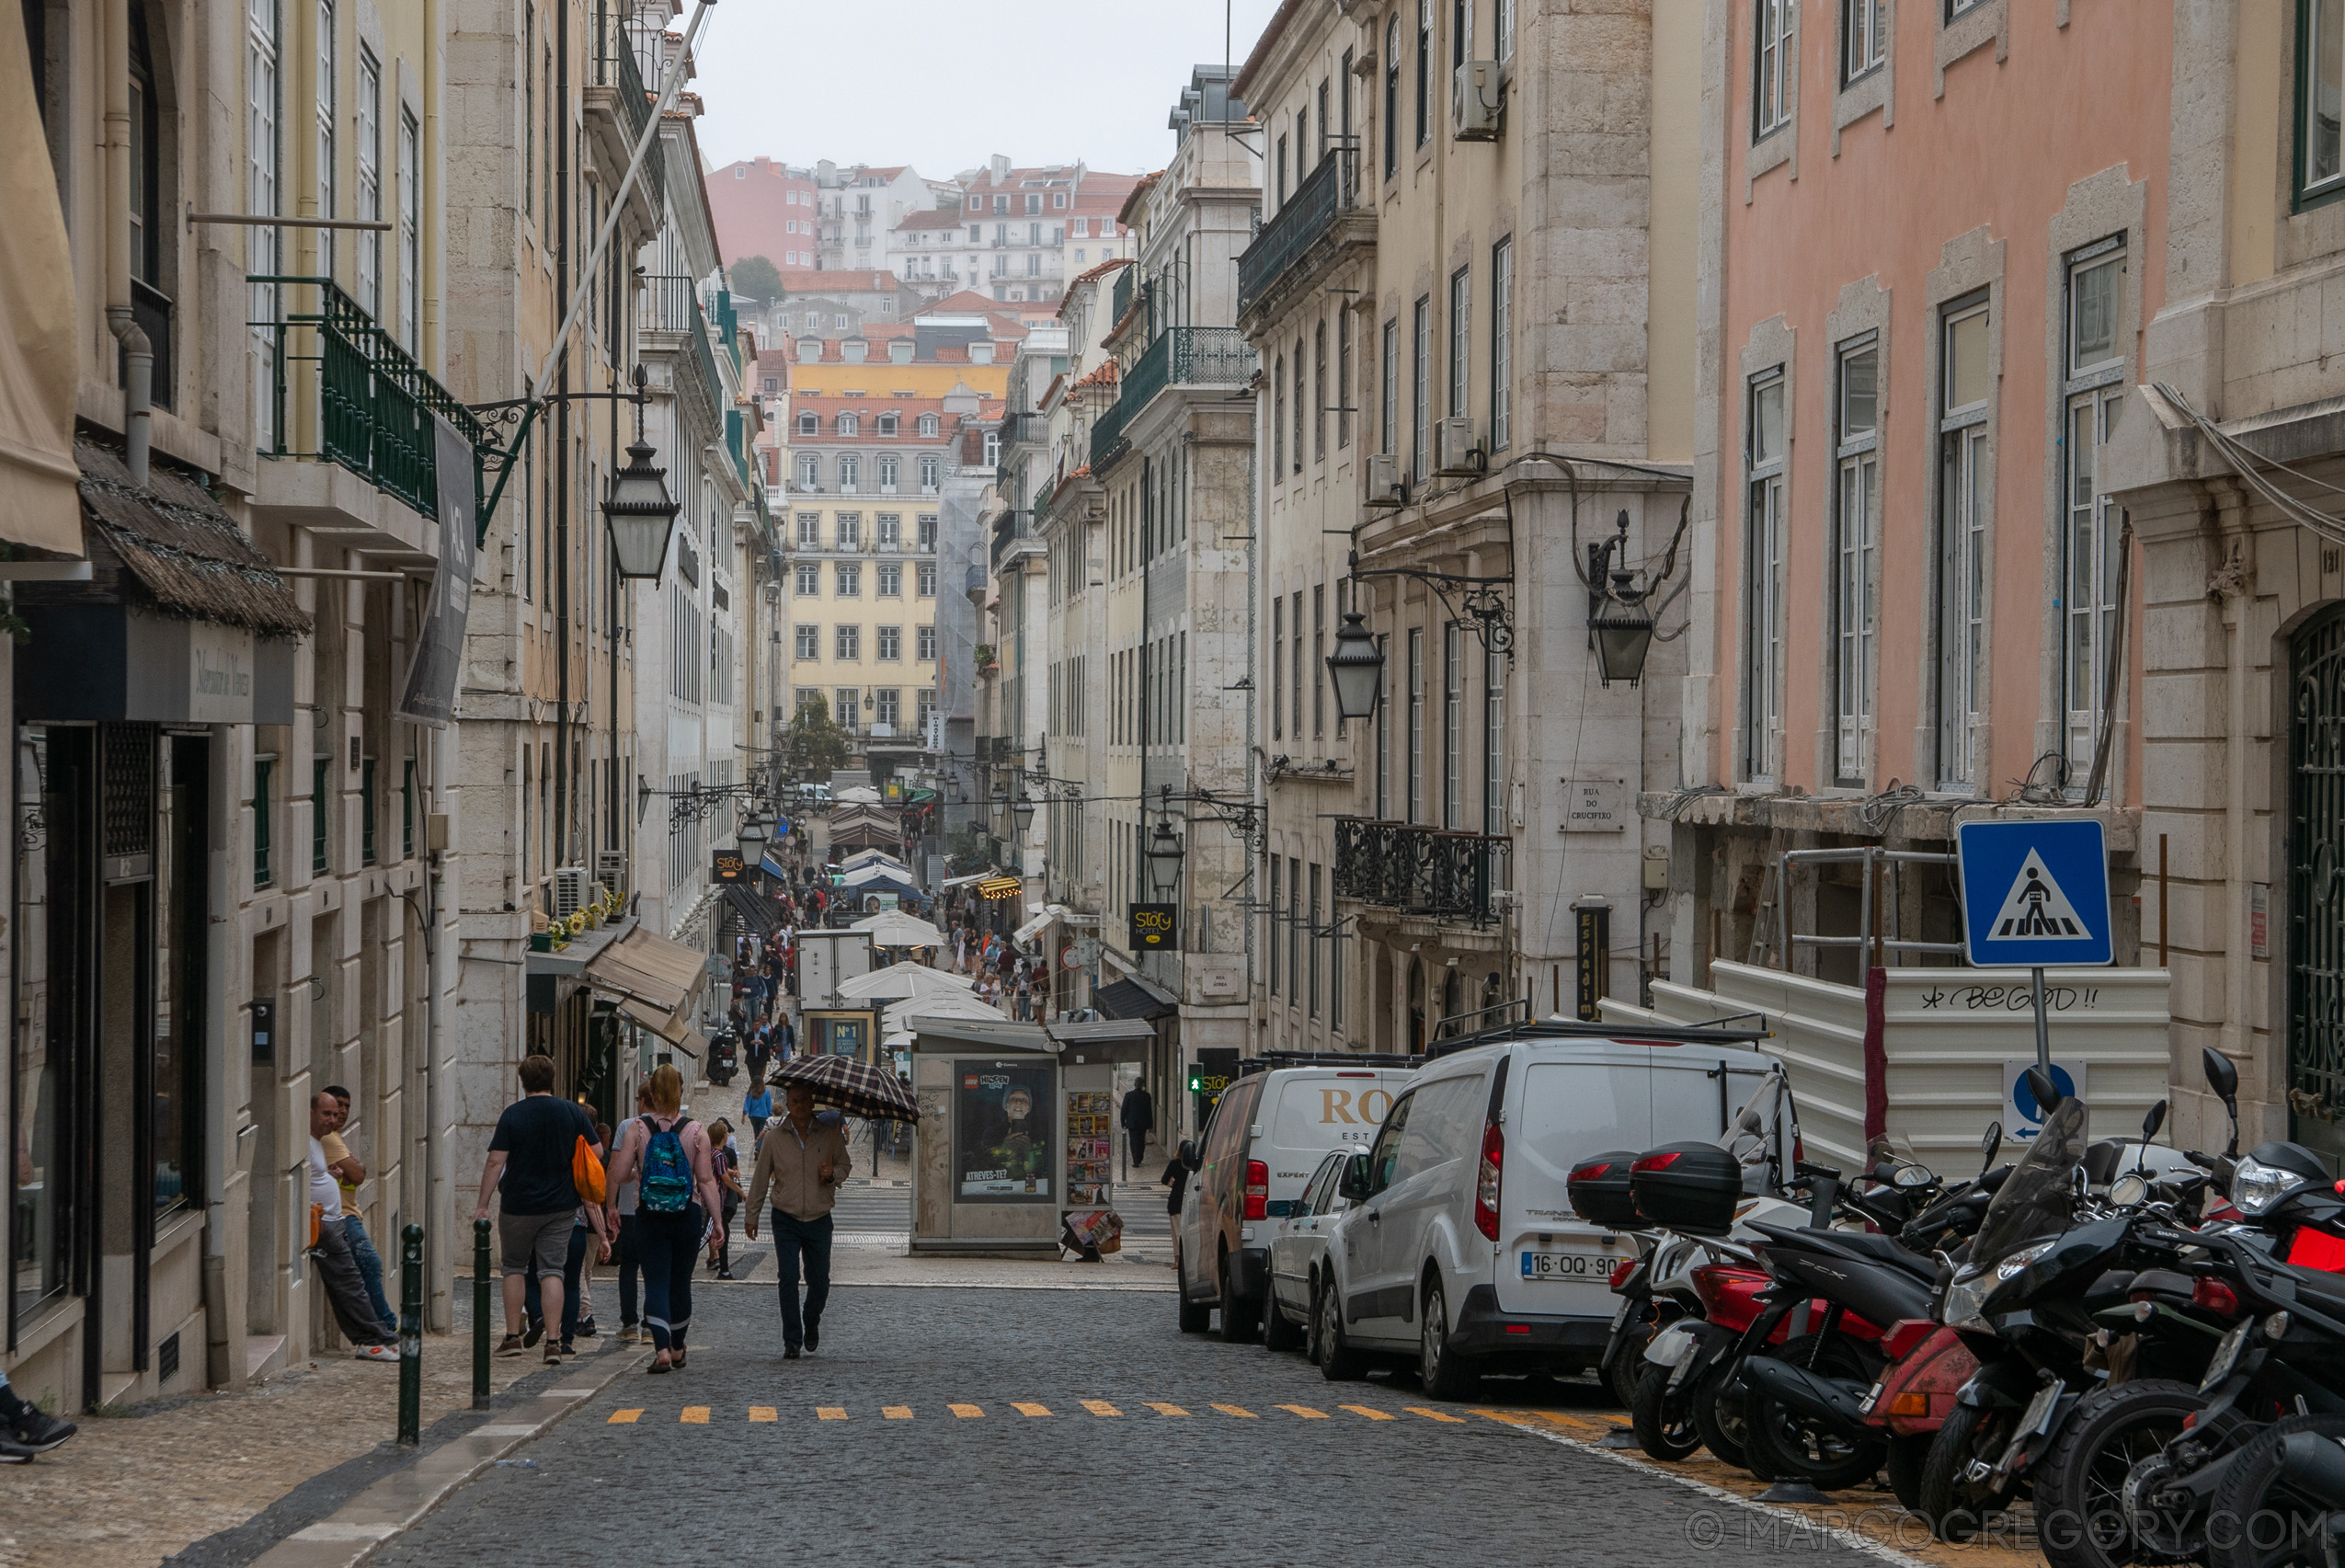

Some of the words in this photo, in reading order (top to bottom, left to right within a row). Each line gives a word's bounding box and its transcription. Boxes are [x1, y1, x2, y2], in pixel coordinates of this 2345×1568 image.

[1583, 788, 1600, 796] RUA
[1585, 799, 1597, 807] DO
[1571, 811, 1612, 820] CRUCIFIXO
[1135, 911, 1172, 931] Story
[1135, 927, 1162, 935] HOTEL
[1318, 1089, 1395, 1126] RO
[966, 1169, 1008, 1182] ATREVES-TE?
[1526, 1208, 1575, 1218] TRANSI
[2156, 1230, 2179, 1239] SHAD
